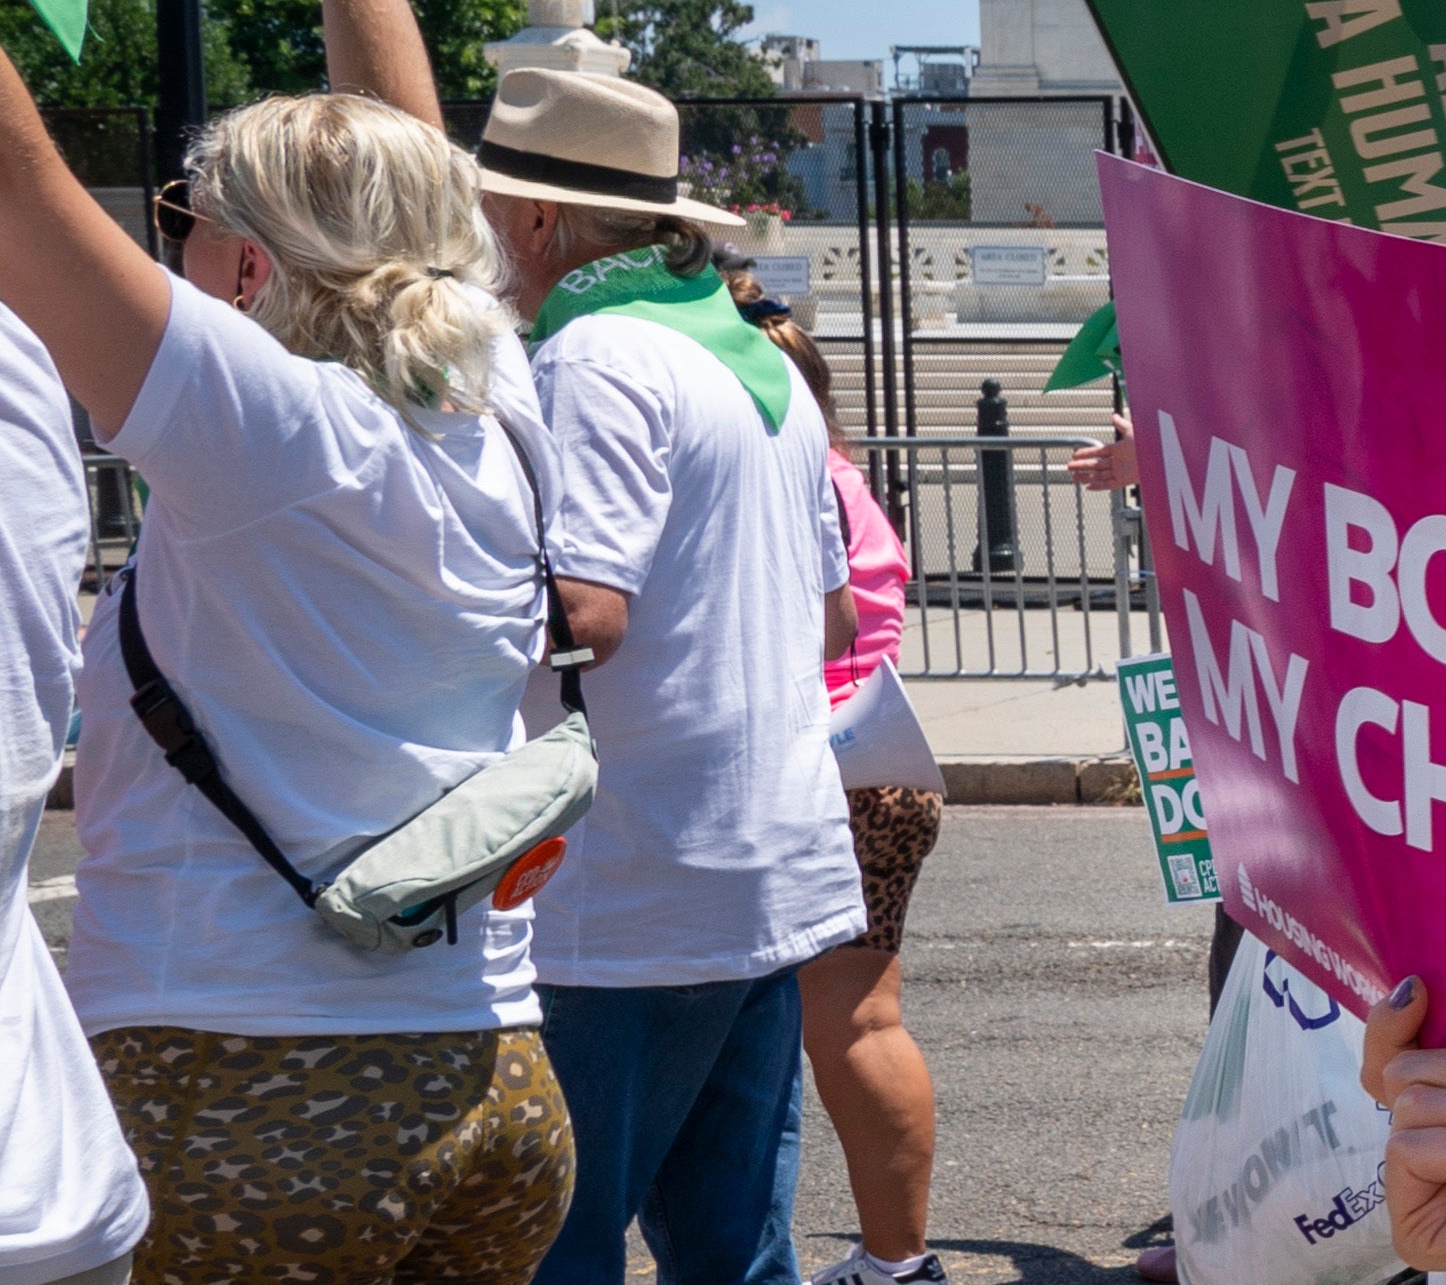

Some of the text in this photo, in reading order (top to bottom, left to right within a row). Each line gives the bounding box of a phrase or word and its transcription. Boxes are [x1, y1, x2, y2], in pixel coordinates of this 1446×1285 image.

[1274, 127, 1347, 210] TEXT
[1157, 409, 1297, 604] MY
[1125, 669, 1181, 715] WE
[1182, 589, 1309, 786] MY
[1254, 887, 1332, 972] HOUSING
[1293, 1186, 1386, 1246] FedEx
